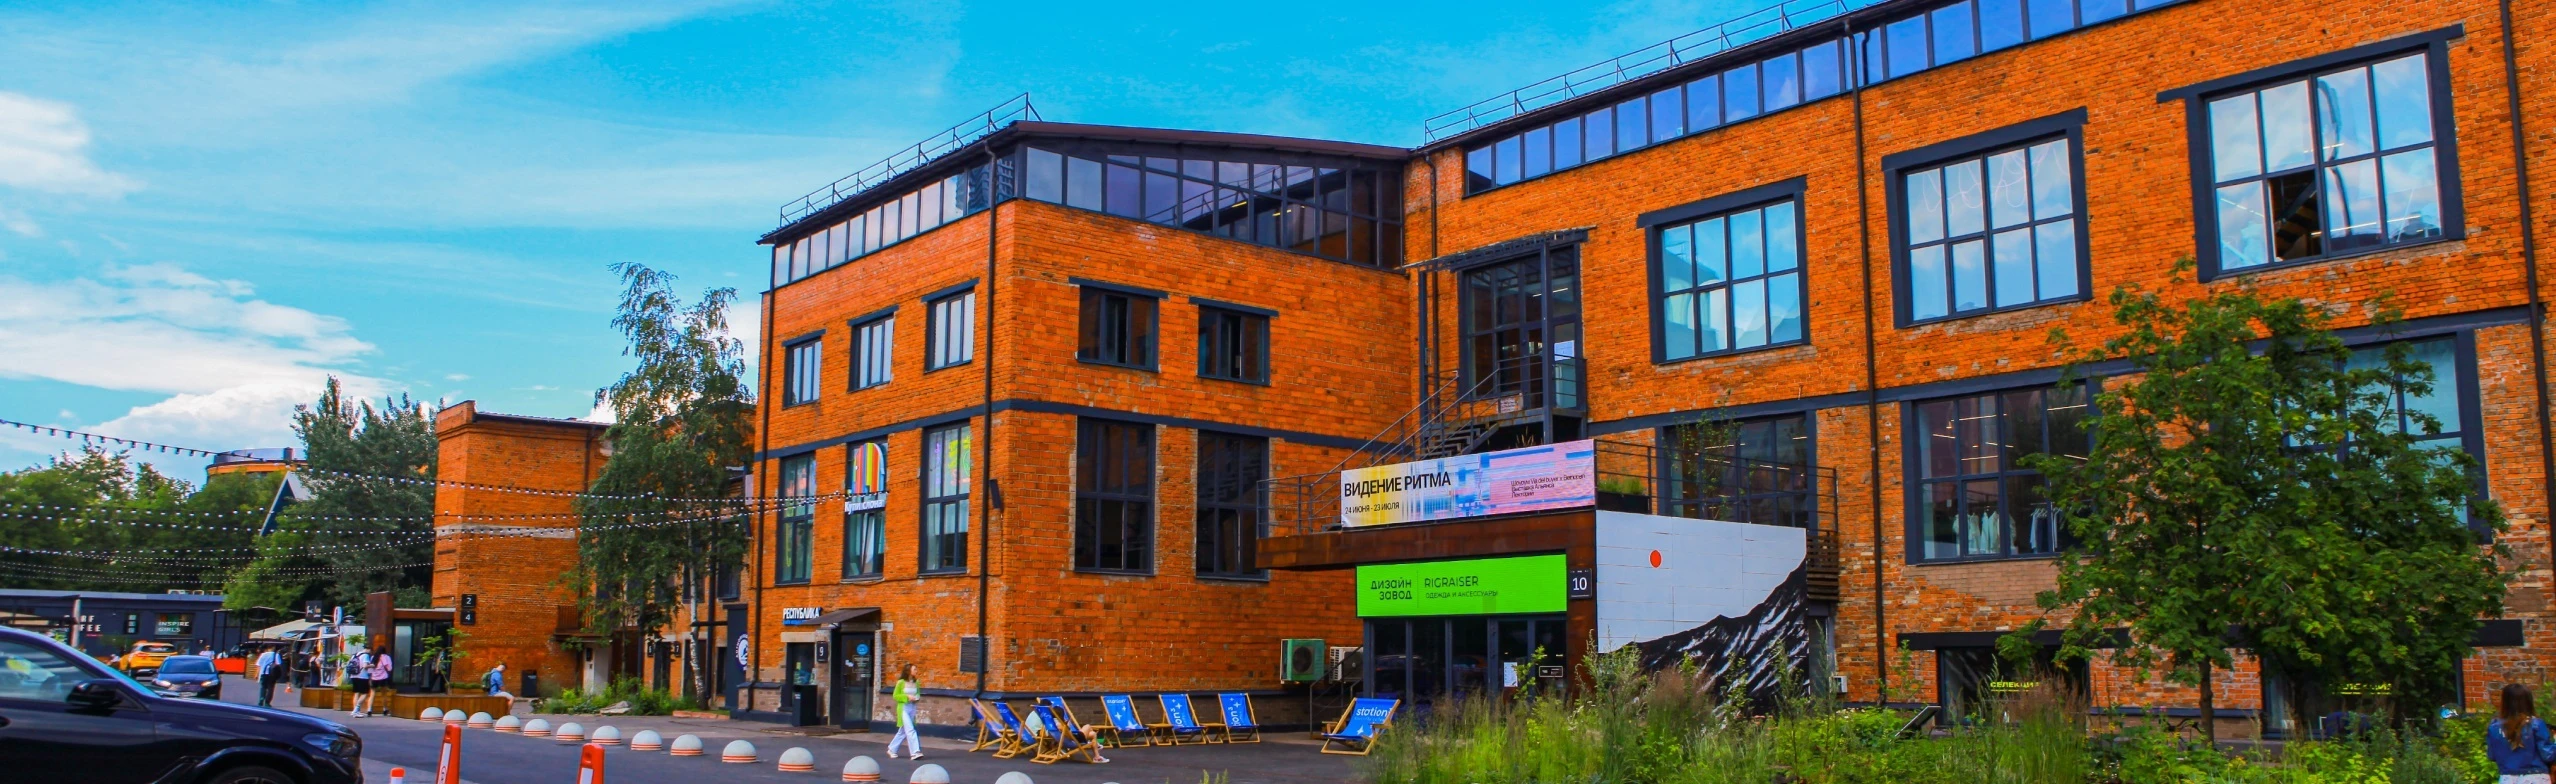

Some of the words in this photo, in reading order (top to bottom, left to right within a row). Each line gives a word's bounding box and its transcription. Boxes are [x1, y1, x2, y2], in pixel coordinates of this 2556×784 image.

[1344, 477, 1402, 498] ВИДЕНИЕ
[1404, 471, 1451, 491] РИТМА
[1345, 506, 1352, 514] 24
[1353, 504, 1370, 513] ИЮНЯ
[1374, 503, 1380, 511] 23
[1381, 502, 1400, 511] ИЮЛЯ
[1424, 575, 1479, 588] RIGRAISER
[1573, 577, 1587, 590] 10
[466, 597, 472, 605] 2
[465, 613, 471, 621] 4
[783, 607, 820, 619] РЕСПУБЛИКА
[819, 646, 824, 657] 9
